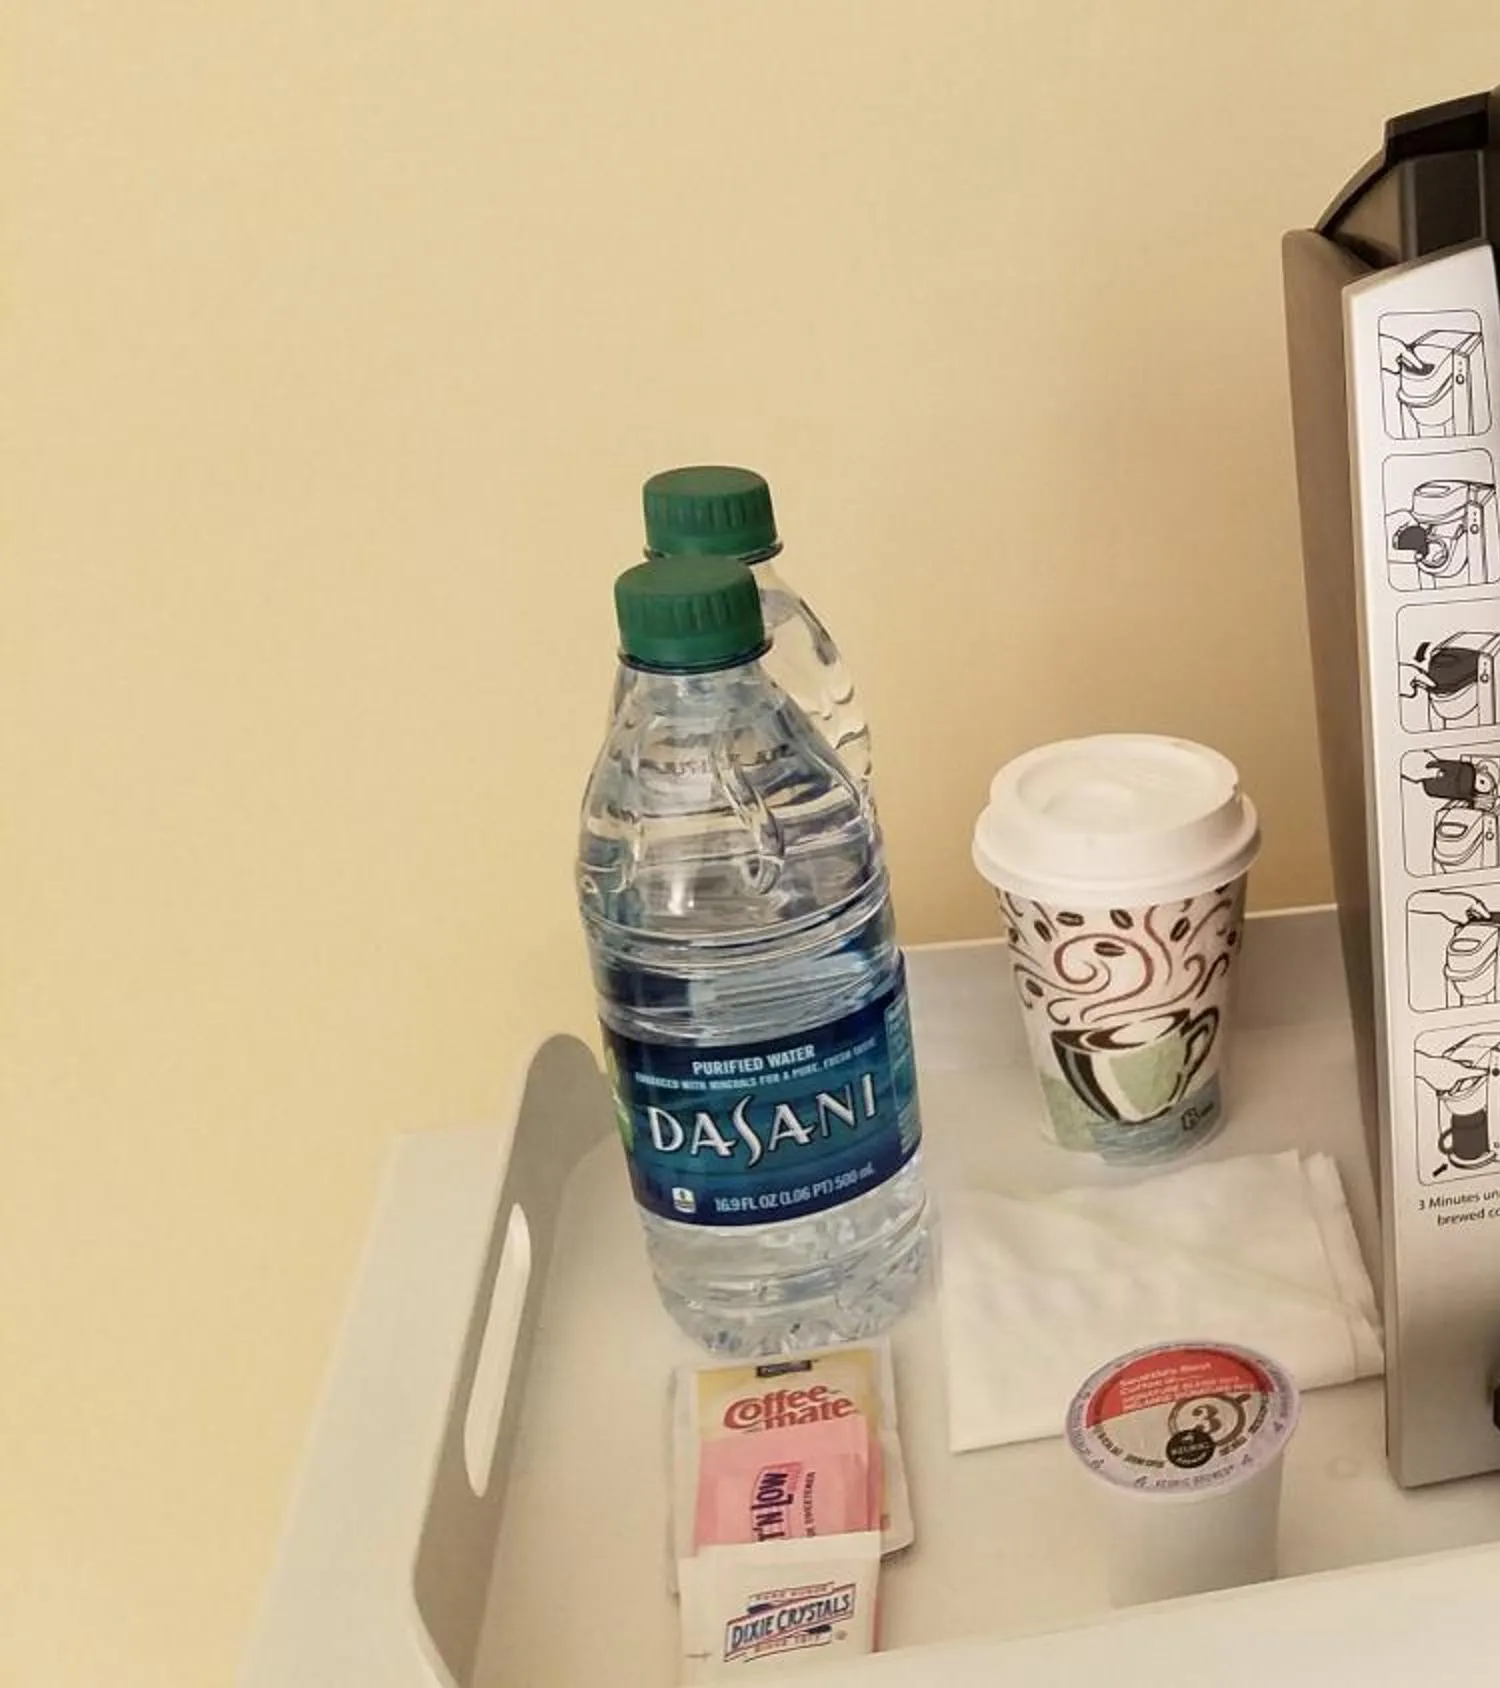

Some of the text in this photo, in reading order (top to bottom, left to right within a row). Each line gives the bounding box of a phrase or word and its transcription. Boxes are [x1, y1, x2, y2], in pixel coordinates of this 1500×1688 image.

[692, 1044, 815, 1075] PURIFIED WATER
[647, 1073, 877, 1167] DASANI
[741, 1197, 757, 1211] FL
[758, 1194, 778, 1209] OZ
[813, 1179, 833, 1197] PT)
[834, 1169, 859, 1190] 500
[1418, 1199, 1426, 1211] 3
[1428, 1193, 1480, 1209] Minutes
[1437, 1208, 1485, 1226] brewed
[723, 1386, 828, 1429] Coffee
[764, 1398, 852, 1429] mate
[1191, 1403, 1222, 1433] 3
[731, 1616, 774, 1650] DIXIE
[777, 1594, 849, 1630] CRYSTALS
